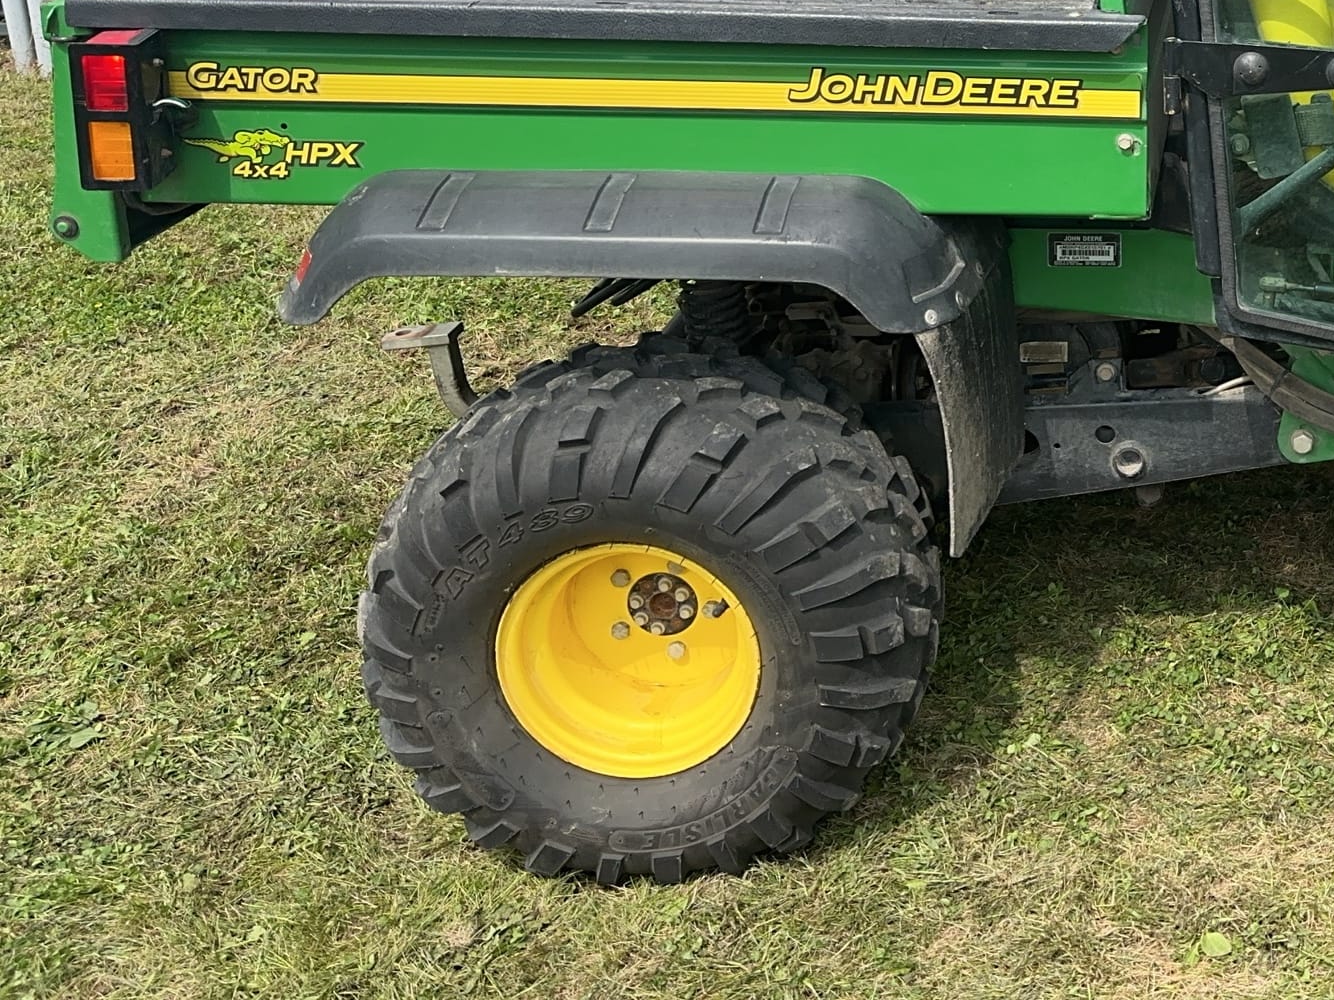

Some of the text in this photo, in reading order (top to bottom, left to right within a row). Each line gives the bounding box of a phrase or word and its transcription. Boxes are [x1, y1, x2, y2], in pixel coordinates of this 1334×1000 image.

[187, 61, 317, 93] GATOR
[788, 67, 1081, 107] JOHN DEERE
[232, 160, 289, 179] 4x4
[283, 141, 362, 168] HPX
[643, 766, 778, 849] CARLISLE
